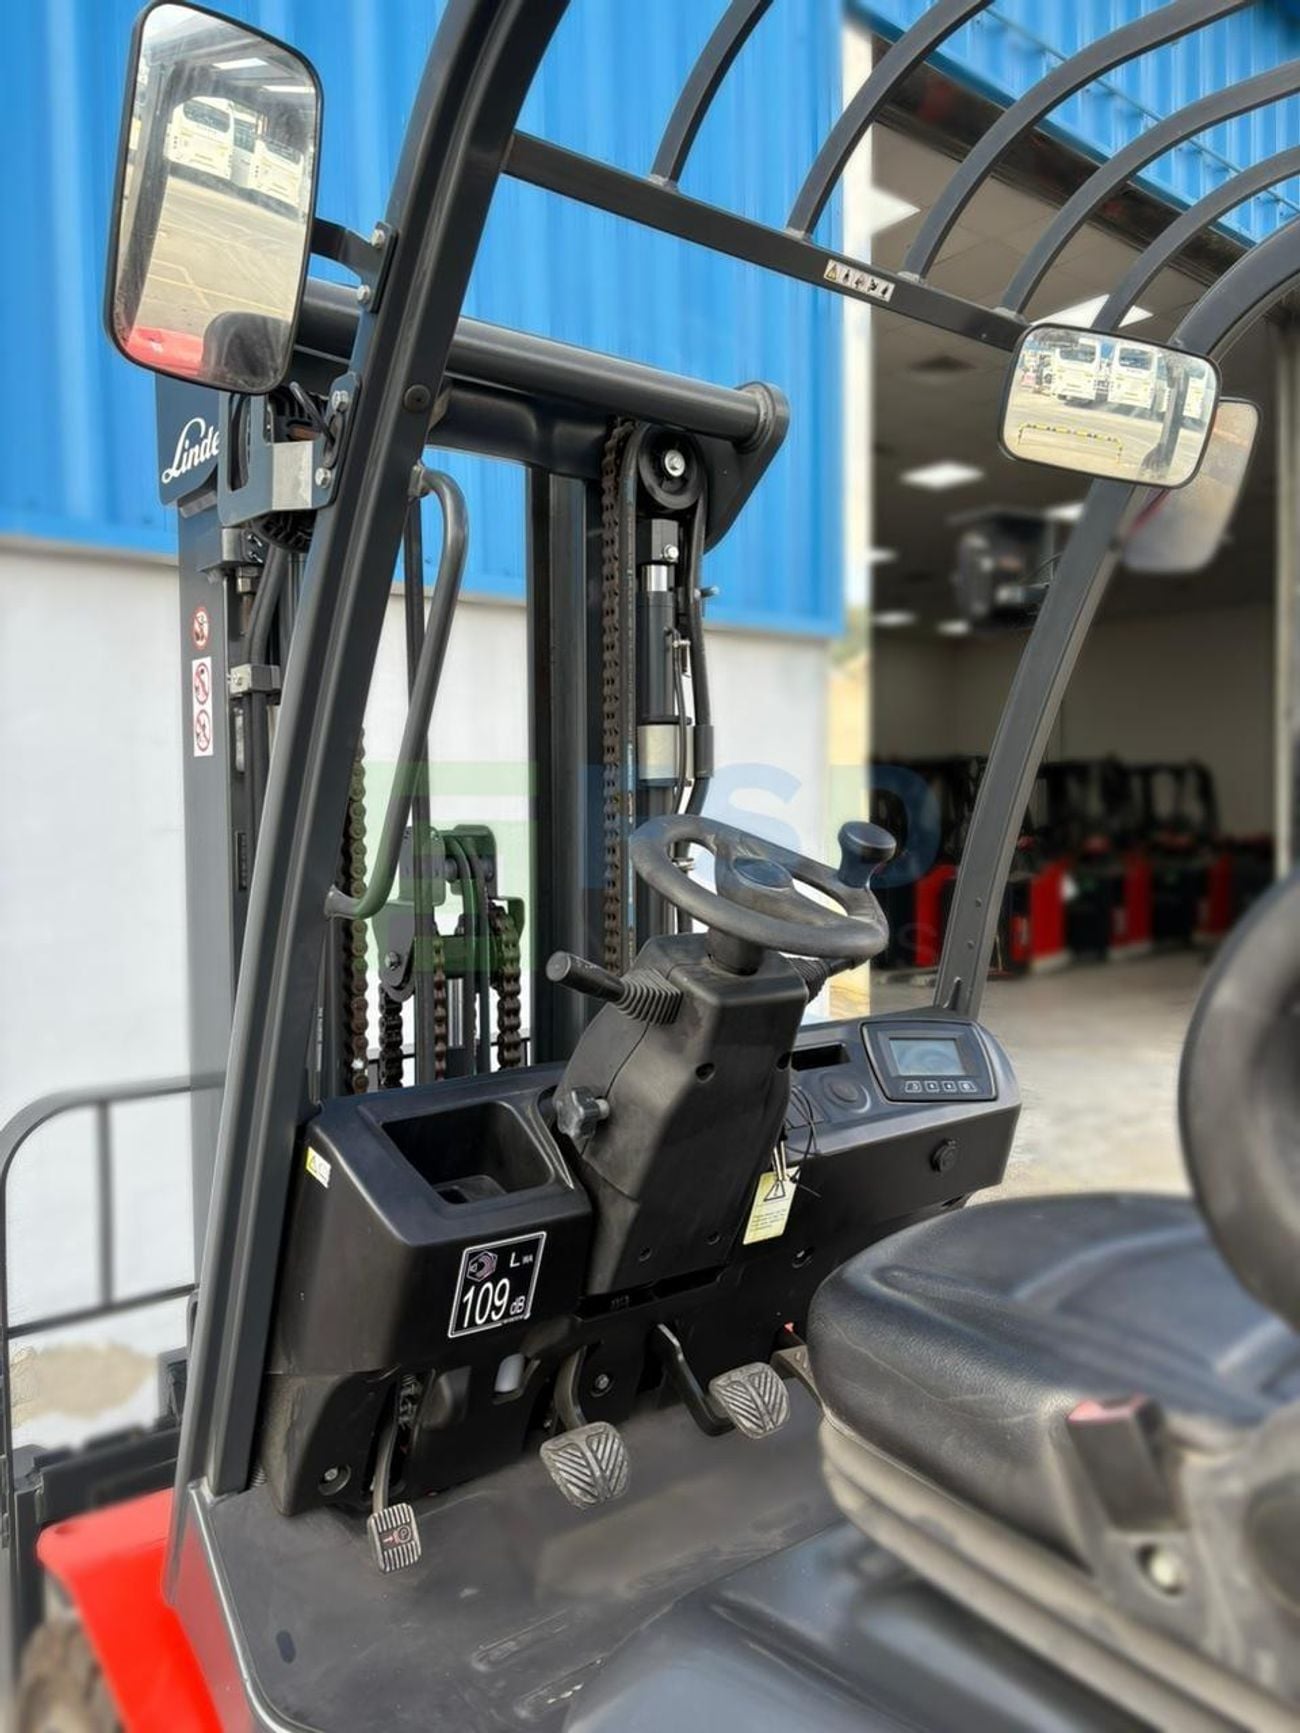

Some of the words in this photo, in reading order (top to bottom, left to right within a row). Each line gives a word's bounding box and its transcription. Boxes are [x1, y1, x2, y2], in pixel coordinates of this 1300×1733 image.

[161, 417, 219, 484] Linde
[463, 1278, 510, 1328] 109
[510, 1296, 525, 1315] dB
